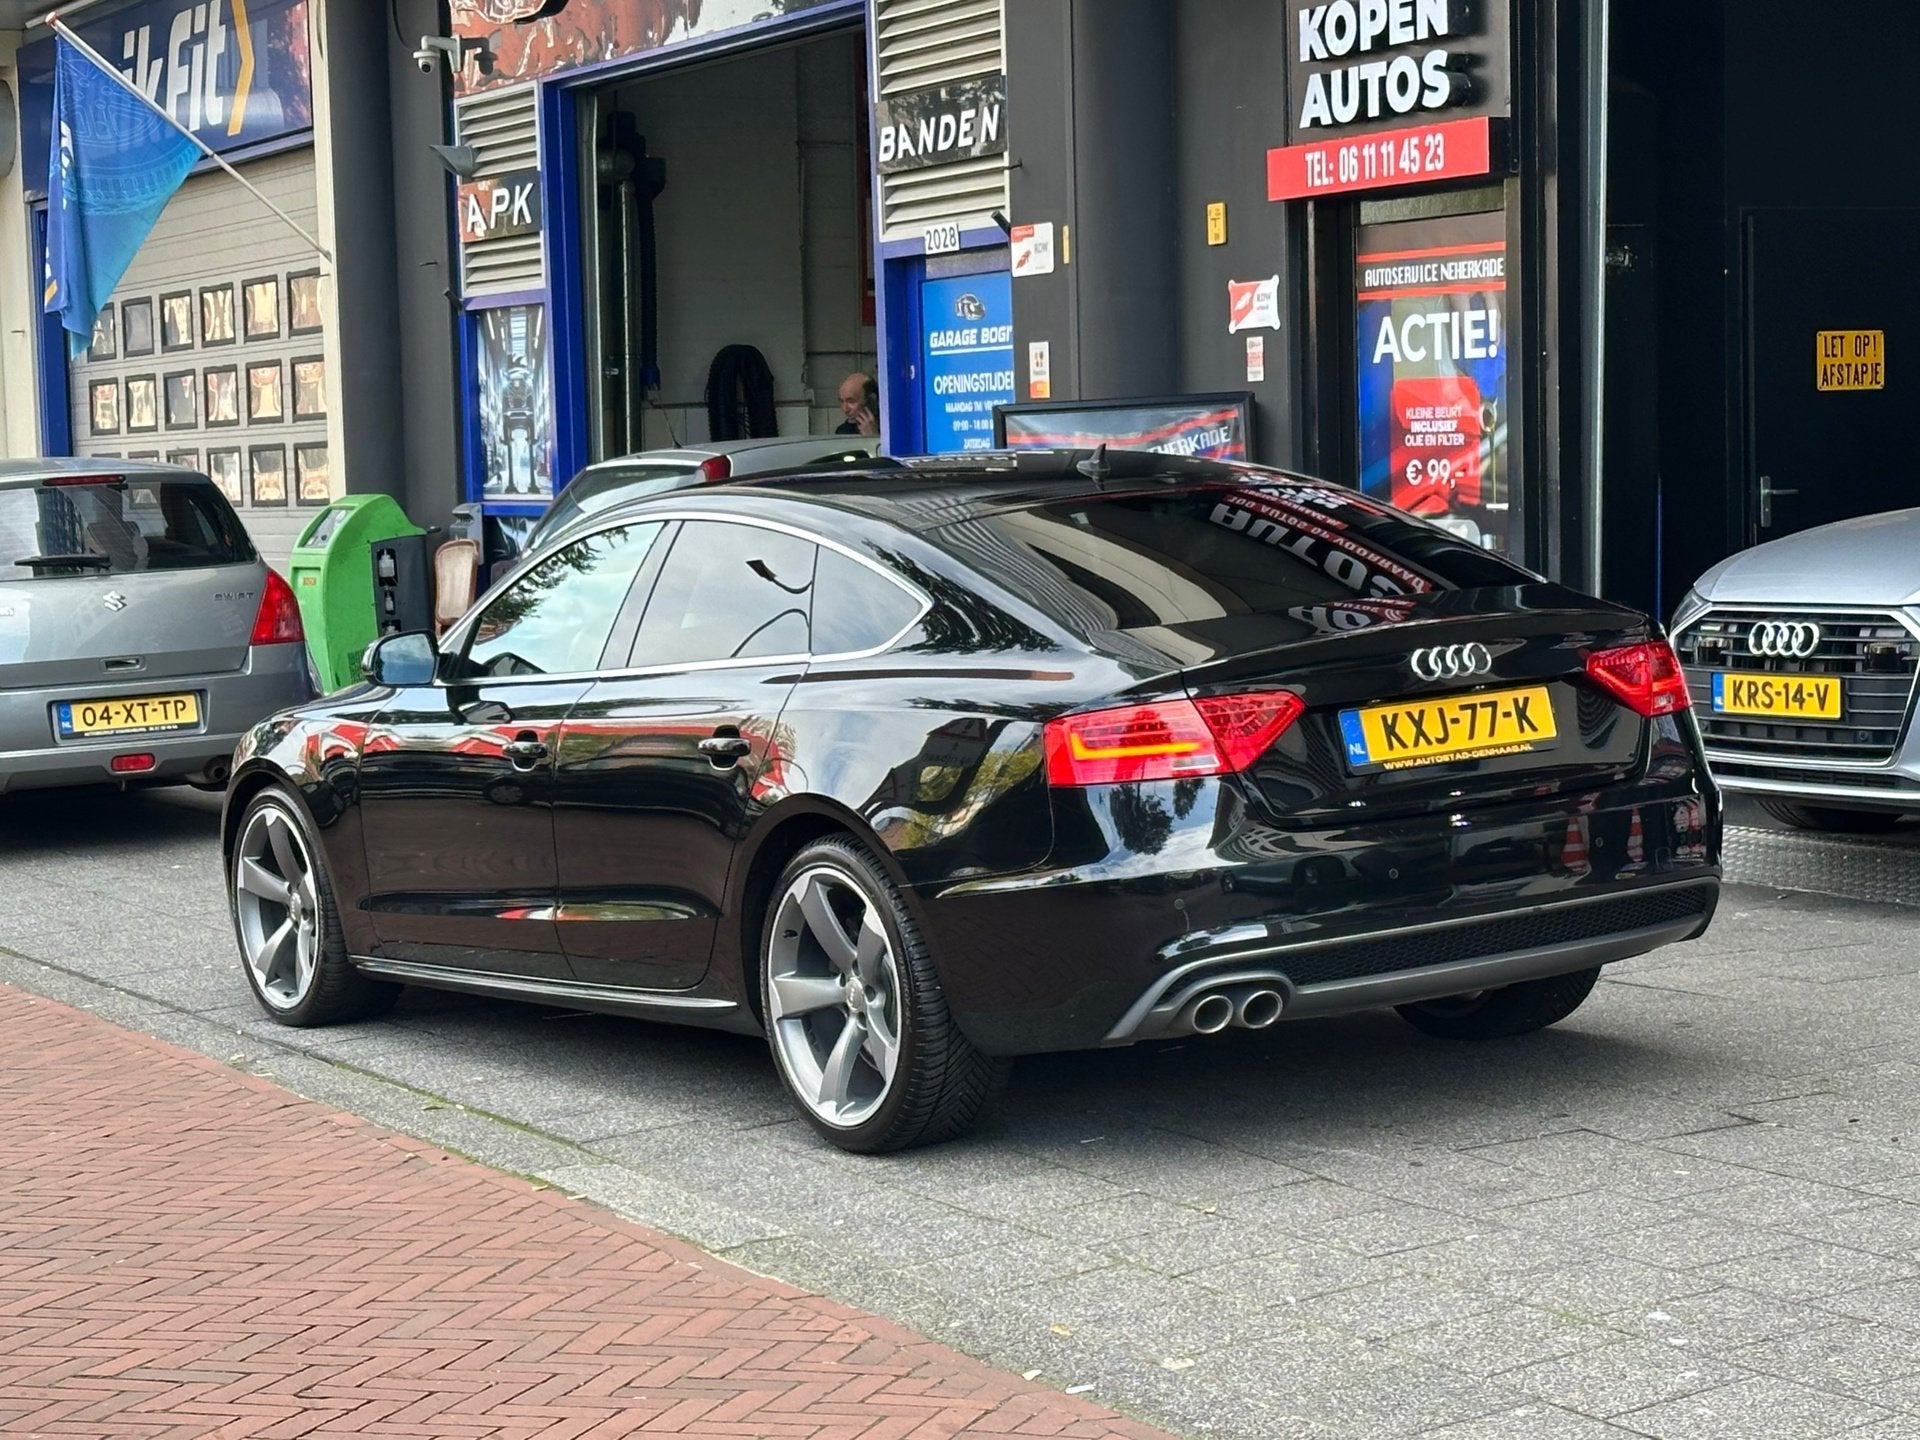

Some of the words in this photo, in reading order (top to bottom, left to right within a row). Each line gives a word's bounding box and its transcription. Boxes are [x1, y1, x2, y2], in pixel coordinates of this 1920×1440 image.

[1299, 0, 1448, 62] KOPEN
[1299, 49, 1450, 128] AUTOS
[879, 104, 999, 162] BANDEN
[1305, 150, 1334, 188] TEL:
[1338, 146, 1358, 184] 06
[1362, 143, 1376, 180] 11
[1380, 140, 1395, 177] 11
[1399, 137, 1420, 175] 45
[1424, 132, 1444, 172] 23
[466, 182, 533, 233] APK
[925, 226, 957, 250] 2028
[1365, 263, 1438, 288] AUTOSERVICE
[1440, 257, 1505, 281] NEHERKADE
[930, 329, 978, 349] GARAGE
[1372, 309, 1498, 364] ACTIE!
[1824, 335, 1845, 357] LET
[1854, 334, 1877, 357] OP!
[1821, 362, 1881, 386] AFSTAPJE
[1405, 406, 1434, 419] KLEINE
[1434, 405, 1462, 419] BEURT
[1410, 419, 1458, 433] INCLUSIEF
[1404, 433, 1424, 447] OLIE
[1424, 433, 1437, 446] EN
[1437, 432, 1465, 446] FILTER
[1406, 459, 1422, 486] €
[1427, 458, 1464, 489] 99,-
[1733, 680, 1829, 711] KRS-14-V
[82, 700, 187, 727] 04-XT-TP
[1381, 696, 1539, 752] KXJ-77-K
[1349, 743, 1366, 755] NL
